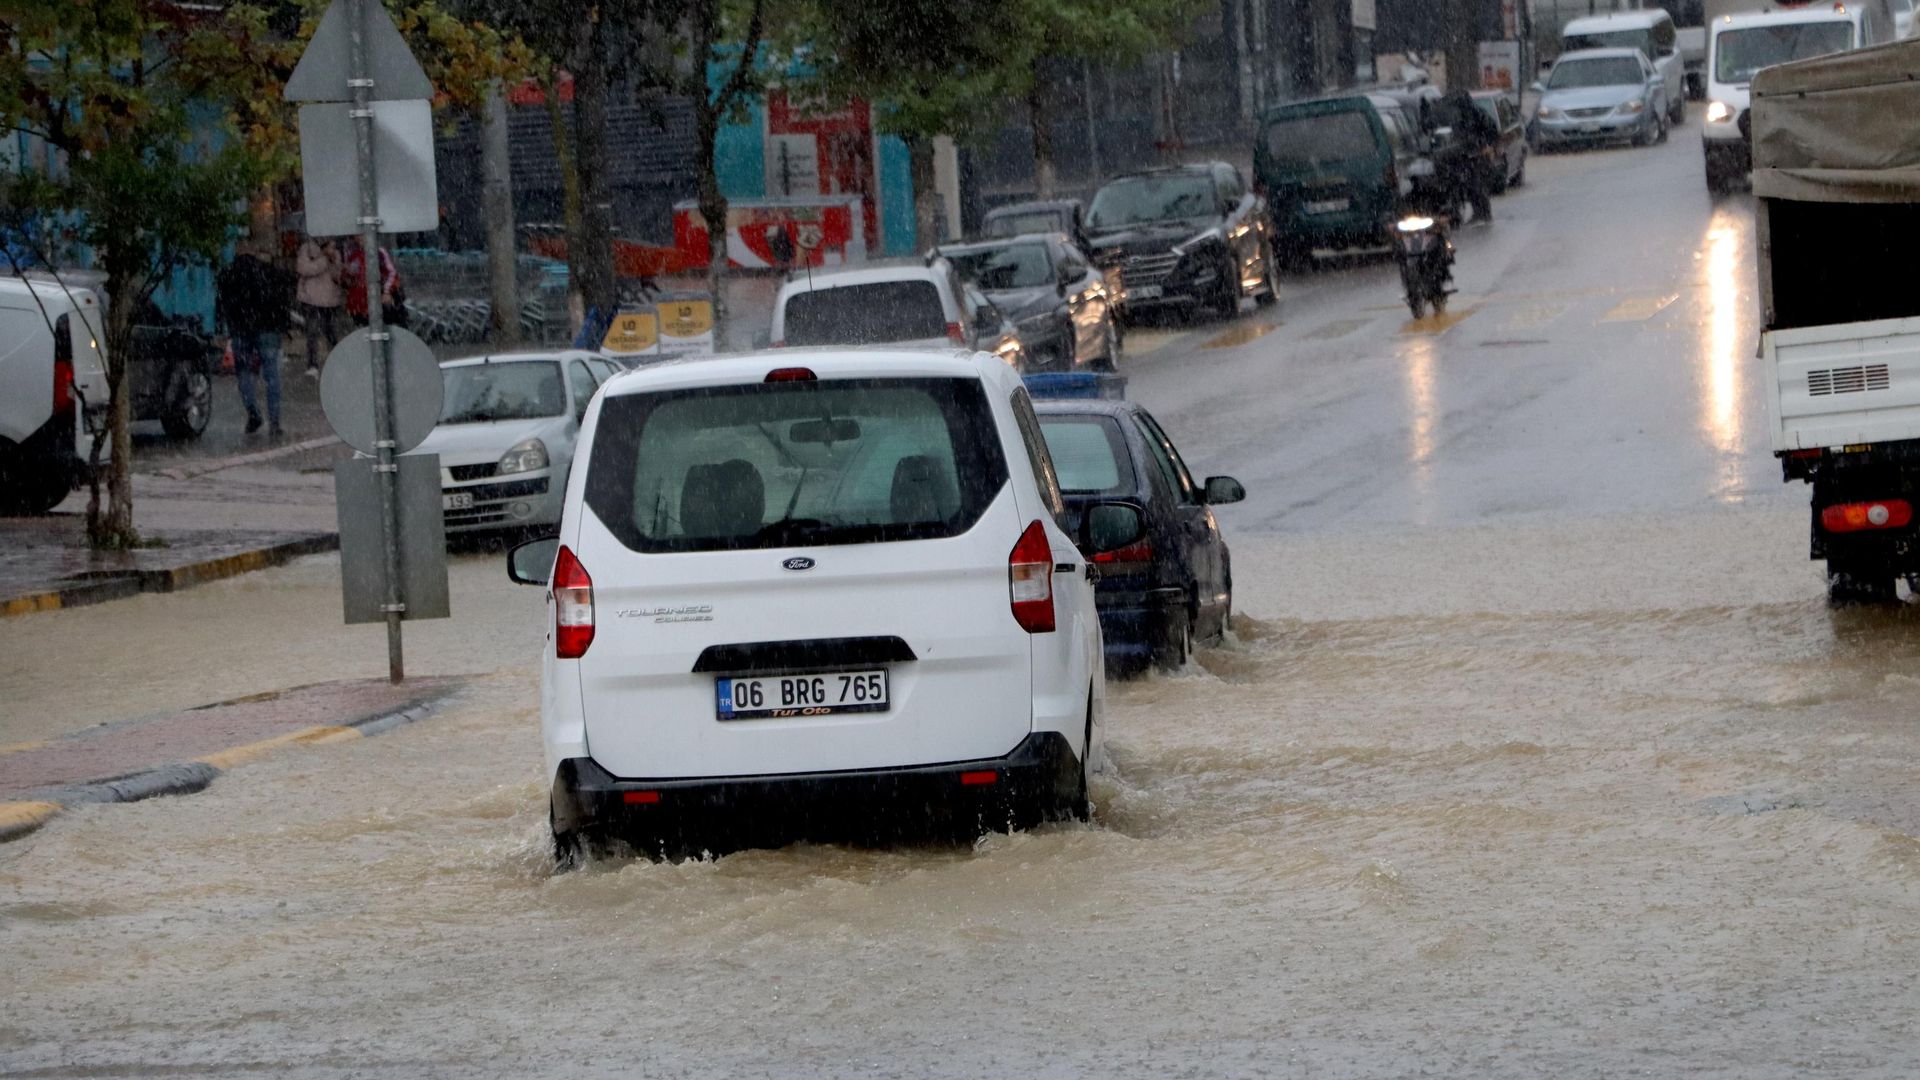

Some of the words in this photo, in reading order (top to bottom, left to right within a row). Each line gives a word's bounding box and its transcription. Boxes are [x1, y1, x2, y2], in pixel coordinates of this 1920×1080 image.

[449, 495, 470, 508] 193
[788, 559, 810, 569] Ford
[734, 681, 764, 708] 06
[781, 678, 825, 705] BRG
[838, 674, 881, 702] 765
[719, 698, 731, 706] TR
[771, 708, 800, 717] Tur
[802, 707, 832, 716] Oto
